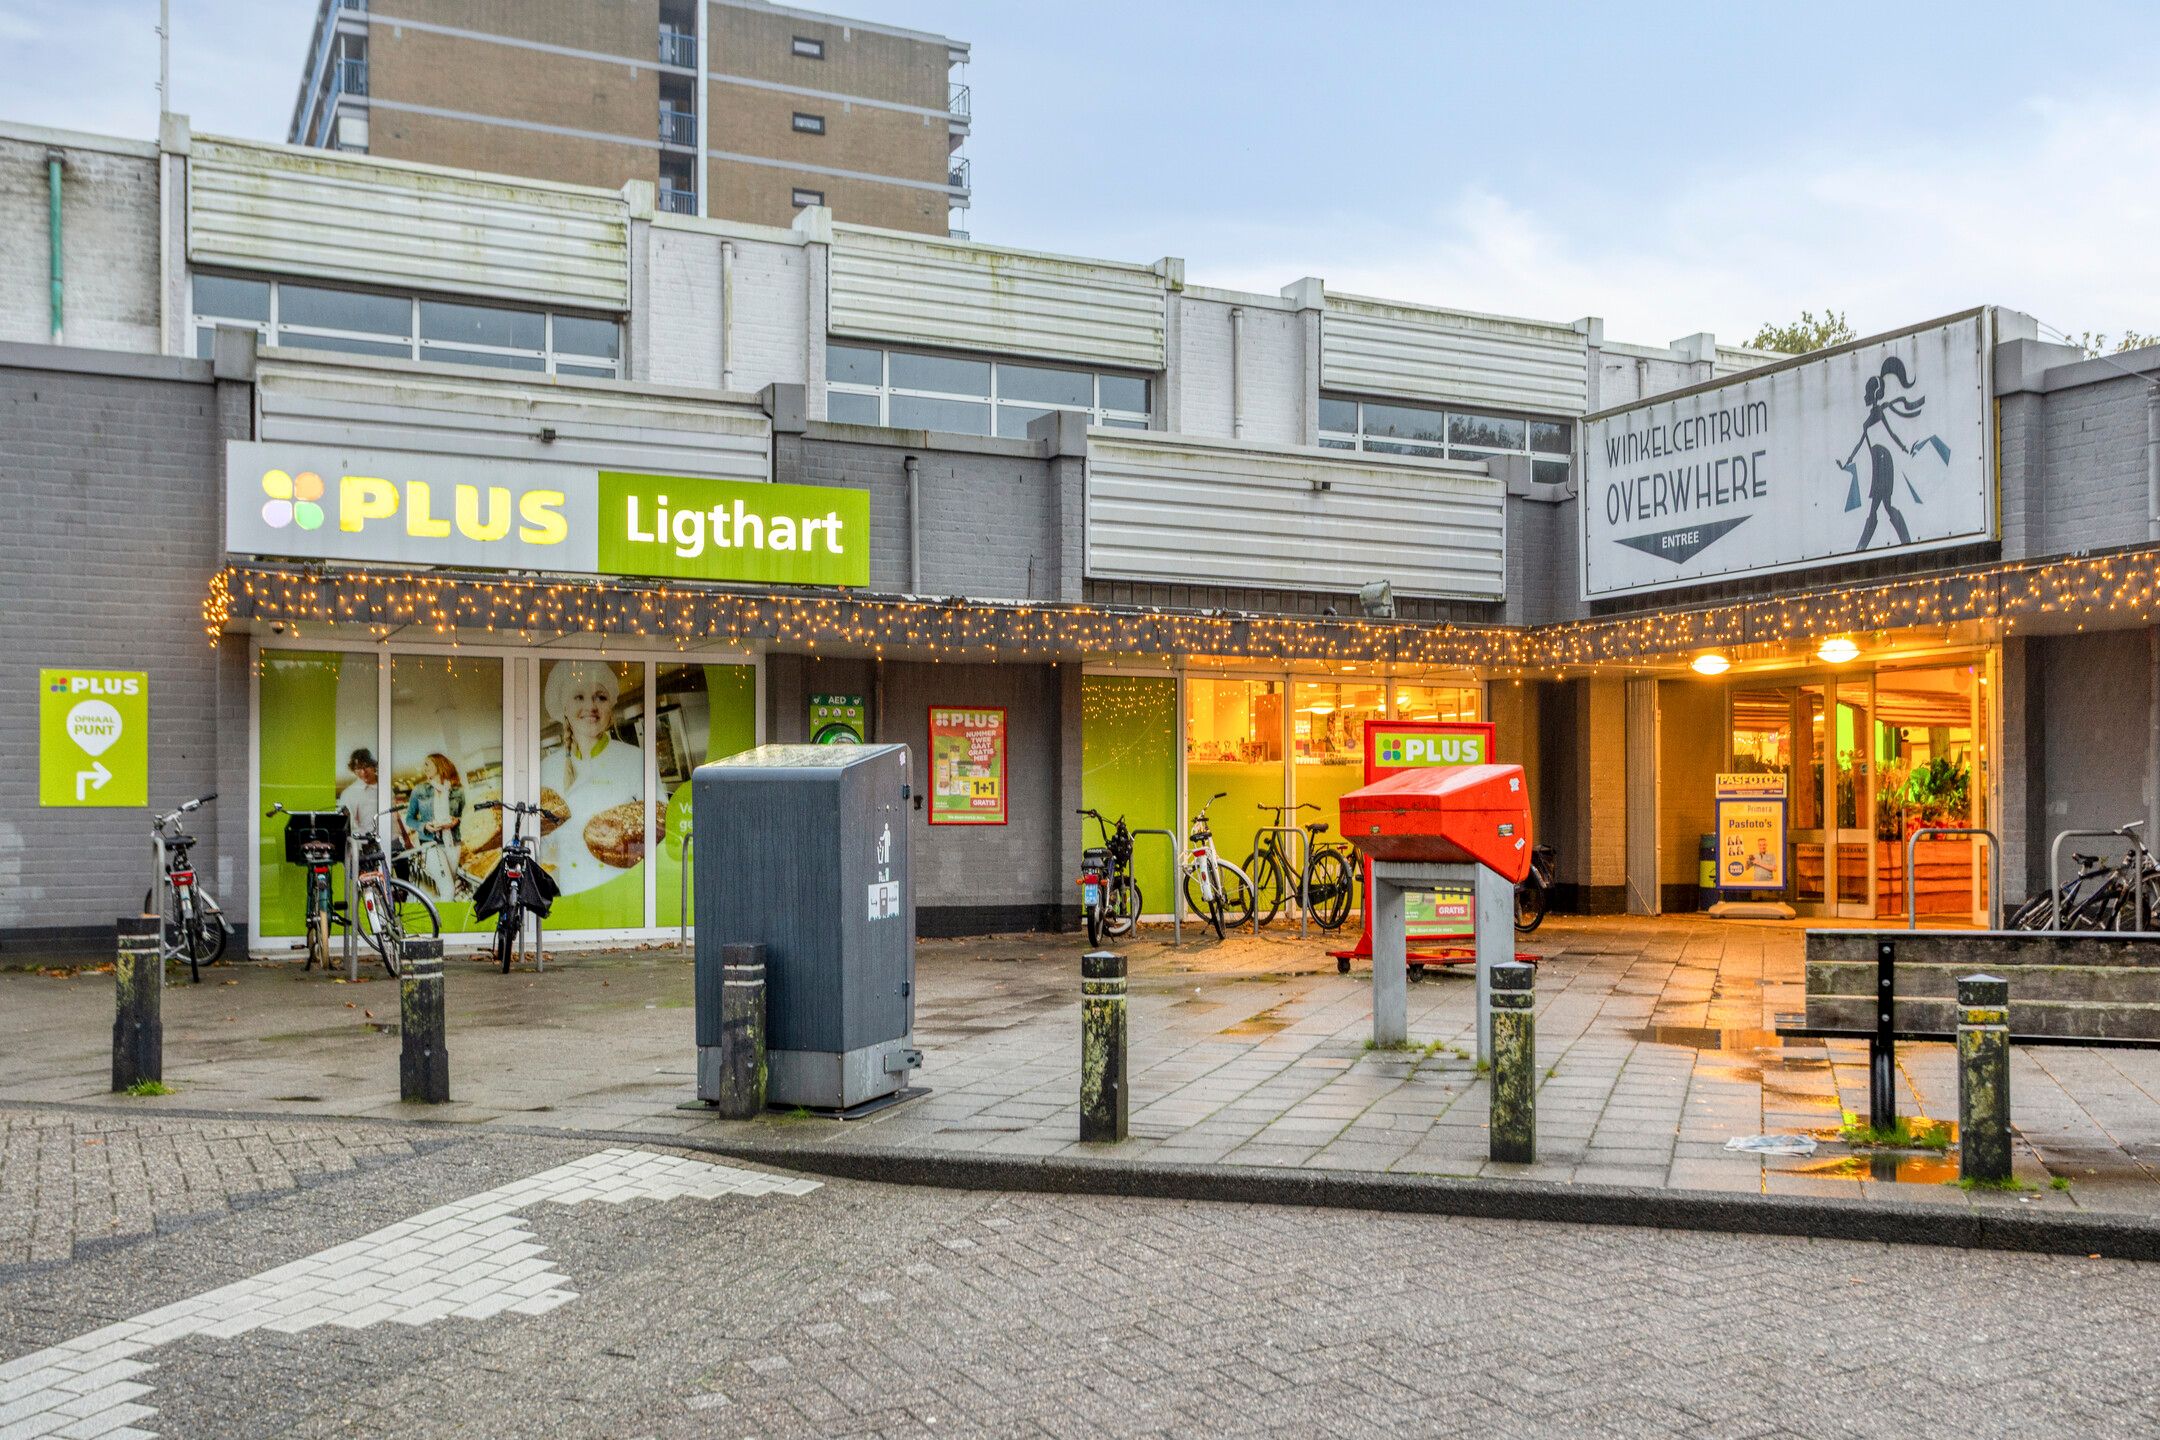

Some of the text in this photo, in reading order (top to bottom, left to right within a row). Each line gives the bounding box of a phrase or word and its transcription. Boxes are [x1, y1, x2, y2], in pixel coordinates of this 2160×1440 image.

[1605, 400, 1768, 469] WINKELCENTRUM
[1606, 449, 1767, 526] OVERWHERE
[339, 475, 844, 559] PLUS Ligthart
[1661, 530, 1700, 549] ENTREE
[71, 676, 139, 696] PLUS
[828, 695, 847, 705] AED
[74, 715, 114, 724] OPHAAL
[951, 713, 999, 728] PLUS
[74, 725, 114, 736] PUNT
[965, 730, 997, 738] NUMMER
[968, 748, 995, 756] GRATIS
[1405, 738, 1479, 763] PLUS
[1719, 775, 1785, 785] PASFOTO'S
[973, 781, 995, 795] 1+1
[1728, 819, 1773, 829] Pasfoto's
[1438, 906, 1465, 915] GRATIS
